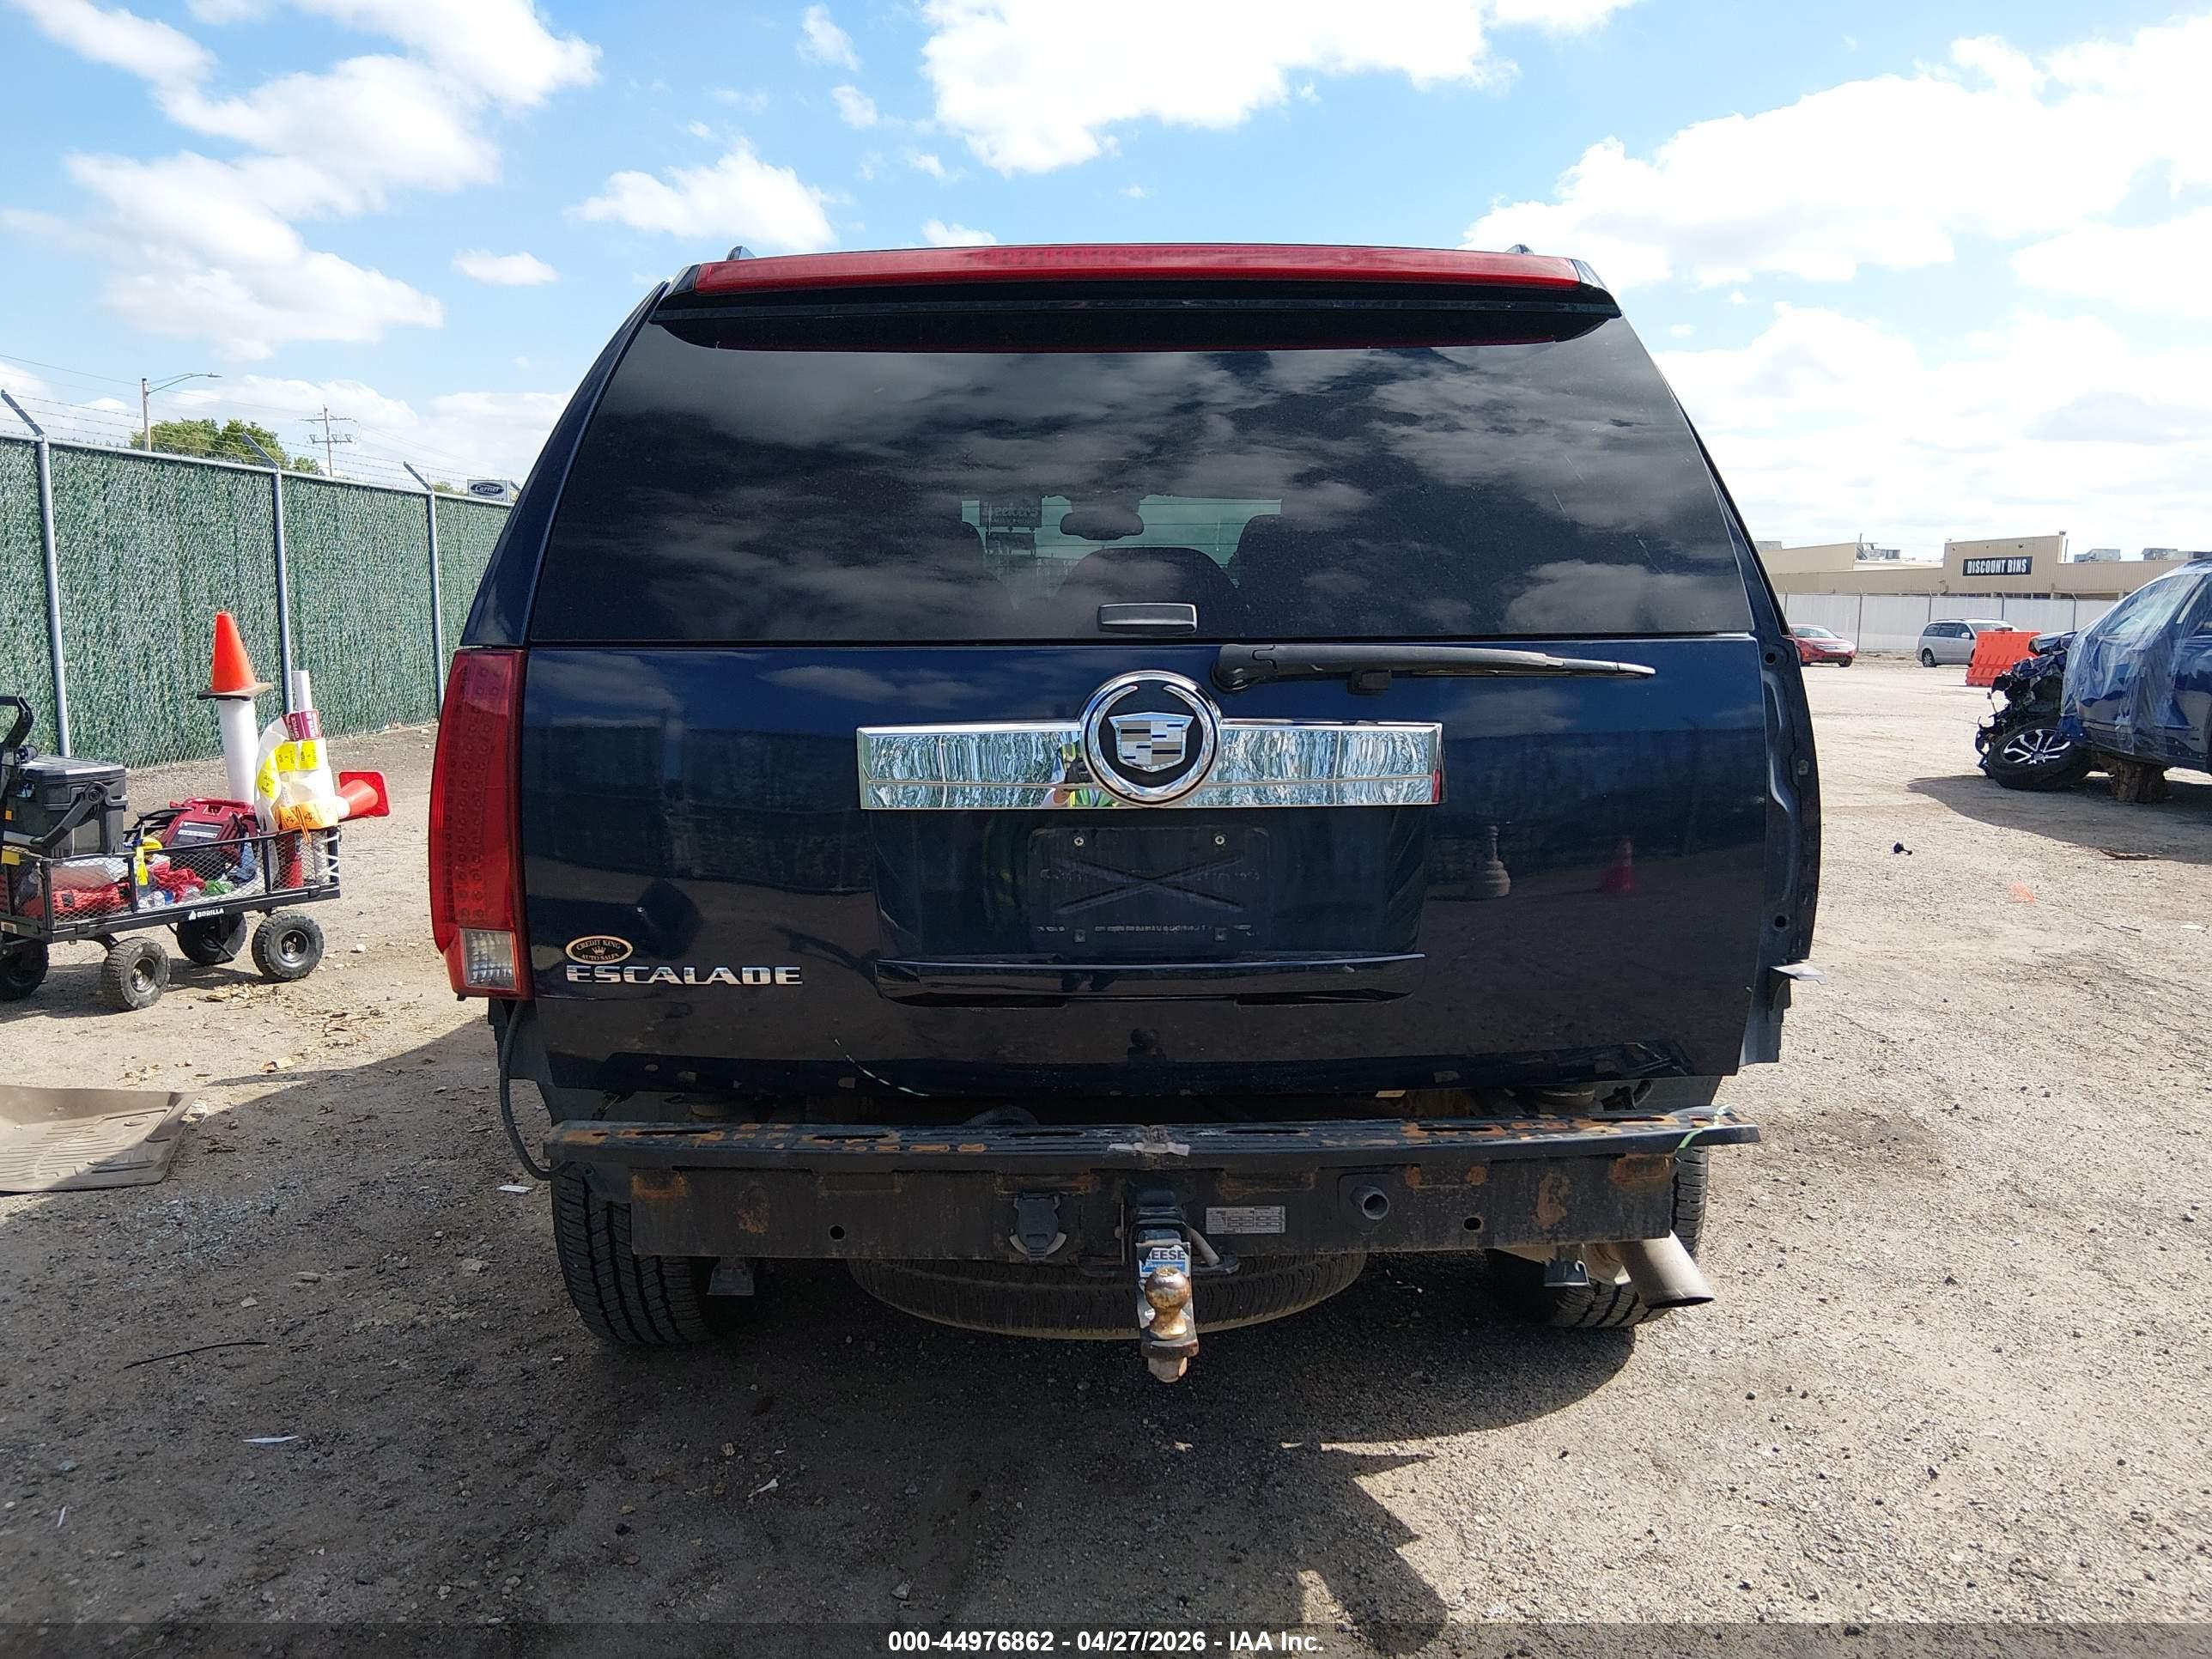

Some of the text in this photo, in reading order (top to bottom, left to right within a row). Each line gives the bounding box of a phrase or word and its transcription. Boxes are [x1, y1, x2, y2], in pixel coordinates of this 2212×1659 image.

[1966, 558, 2027, 574] DISCOUNT BINS
[576, 939, 621, 951] CREDIT KING
[600, 952, 620, 961] SALES
[565, 964, 804, 985] ESCALADE
[1147, 1249, 1186, 1261] EESE
